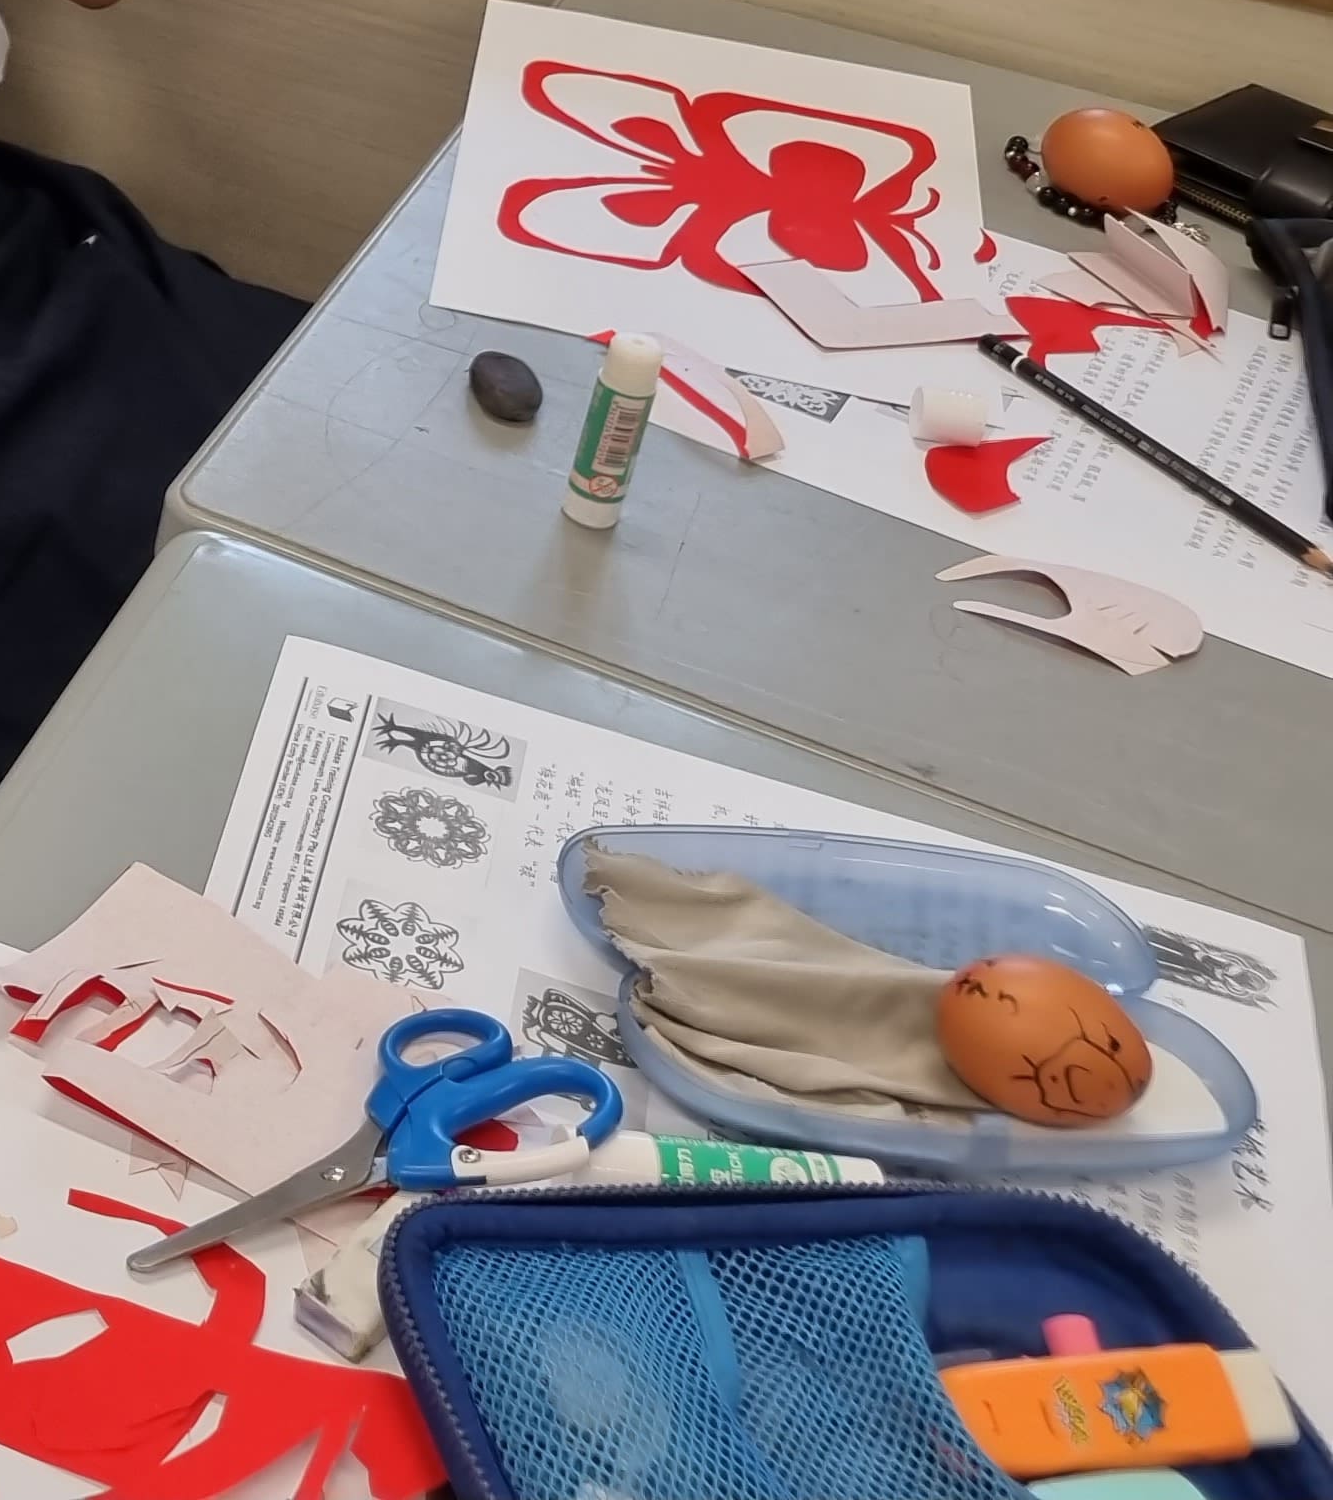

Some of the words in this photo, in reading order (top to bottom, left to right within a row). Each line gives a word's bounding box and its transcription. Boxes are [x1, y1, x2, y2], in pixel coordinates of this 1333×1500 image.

[332, 734, 348, 765] Edubase
[321, 764, 340, 793] Training
[308, 793, 331, 840] Consultancy
[307, 840, 318, 853] Pte
[278, 872, 295, 904] Singapore
